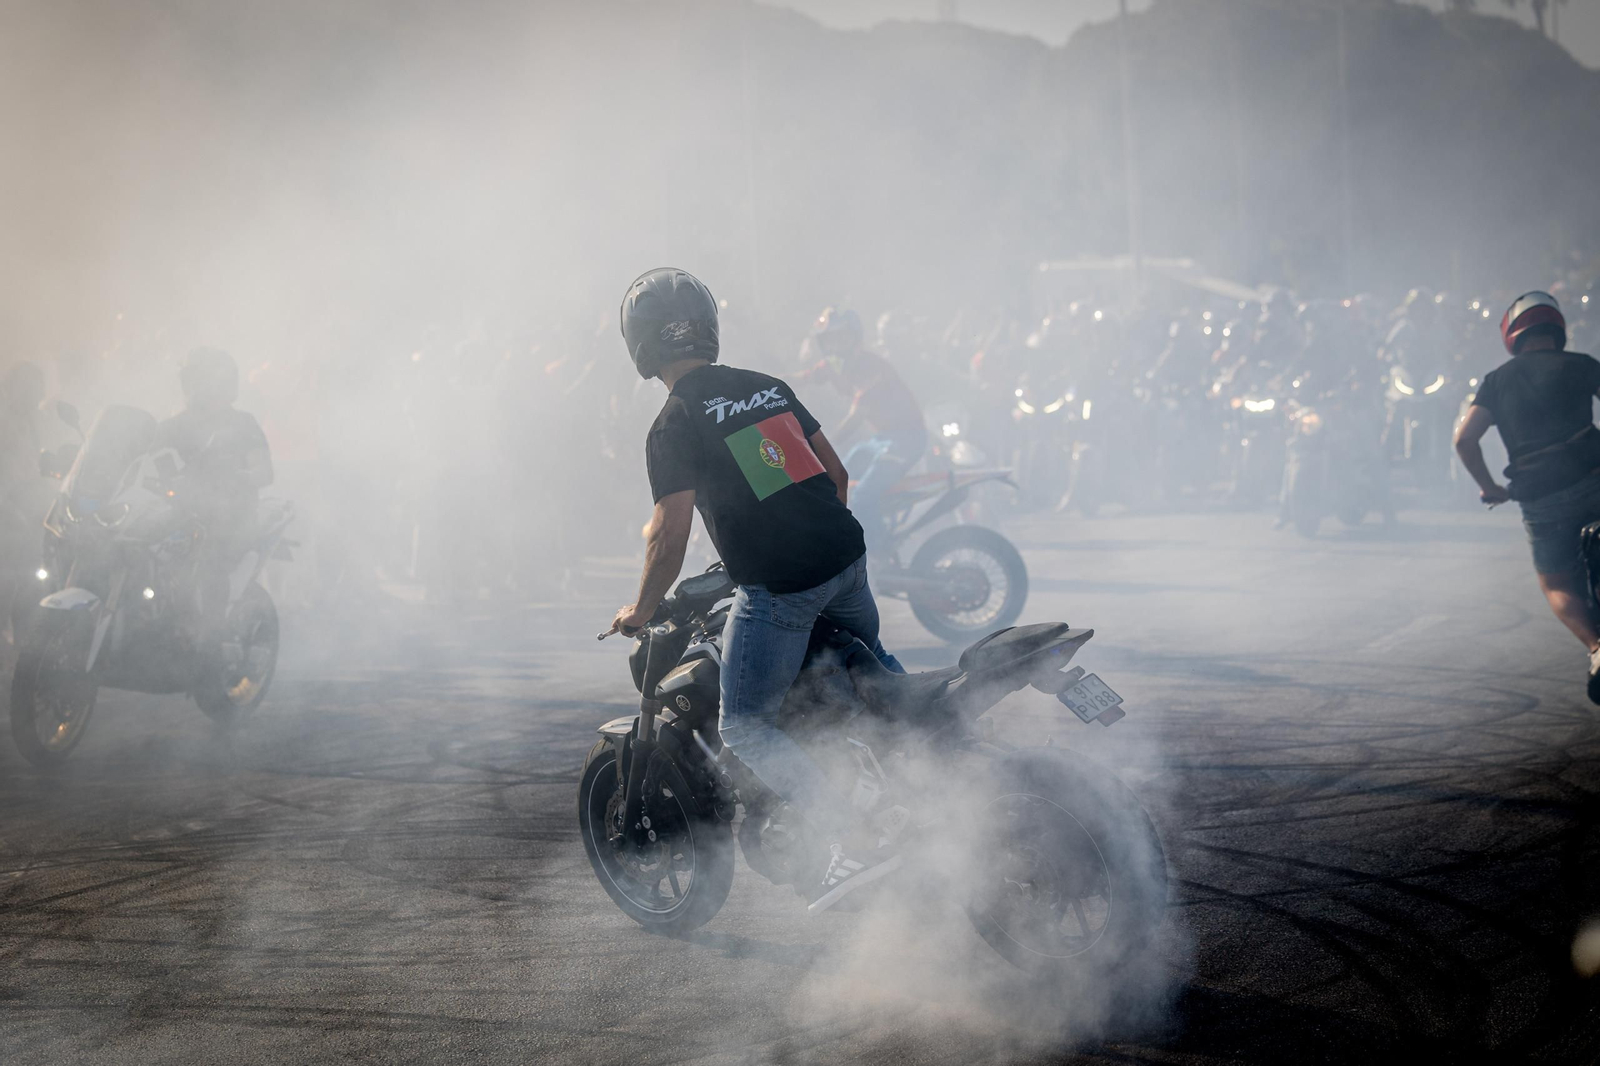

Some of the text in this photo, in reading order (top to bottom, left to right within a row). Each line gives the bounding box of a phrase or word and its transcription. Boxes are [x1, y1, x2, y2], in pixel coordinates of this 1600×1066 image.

[703, 396, 727, 407] Team
[706, 387, 782, 423] TMAX
[763, 398, 788, 410] Portugal
[1074, 683, 1093, 699] 91
[1077, 691, 1116, 718] PV88
